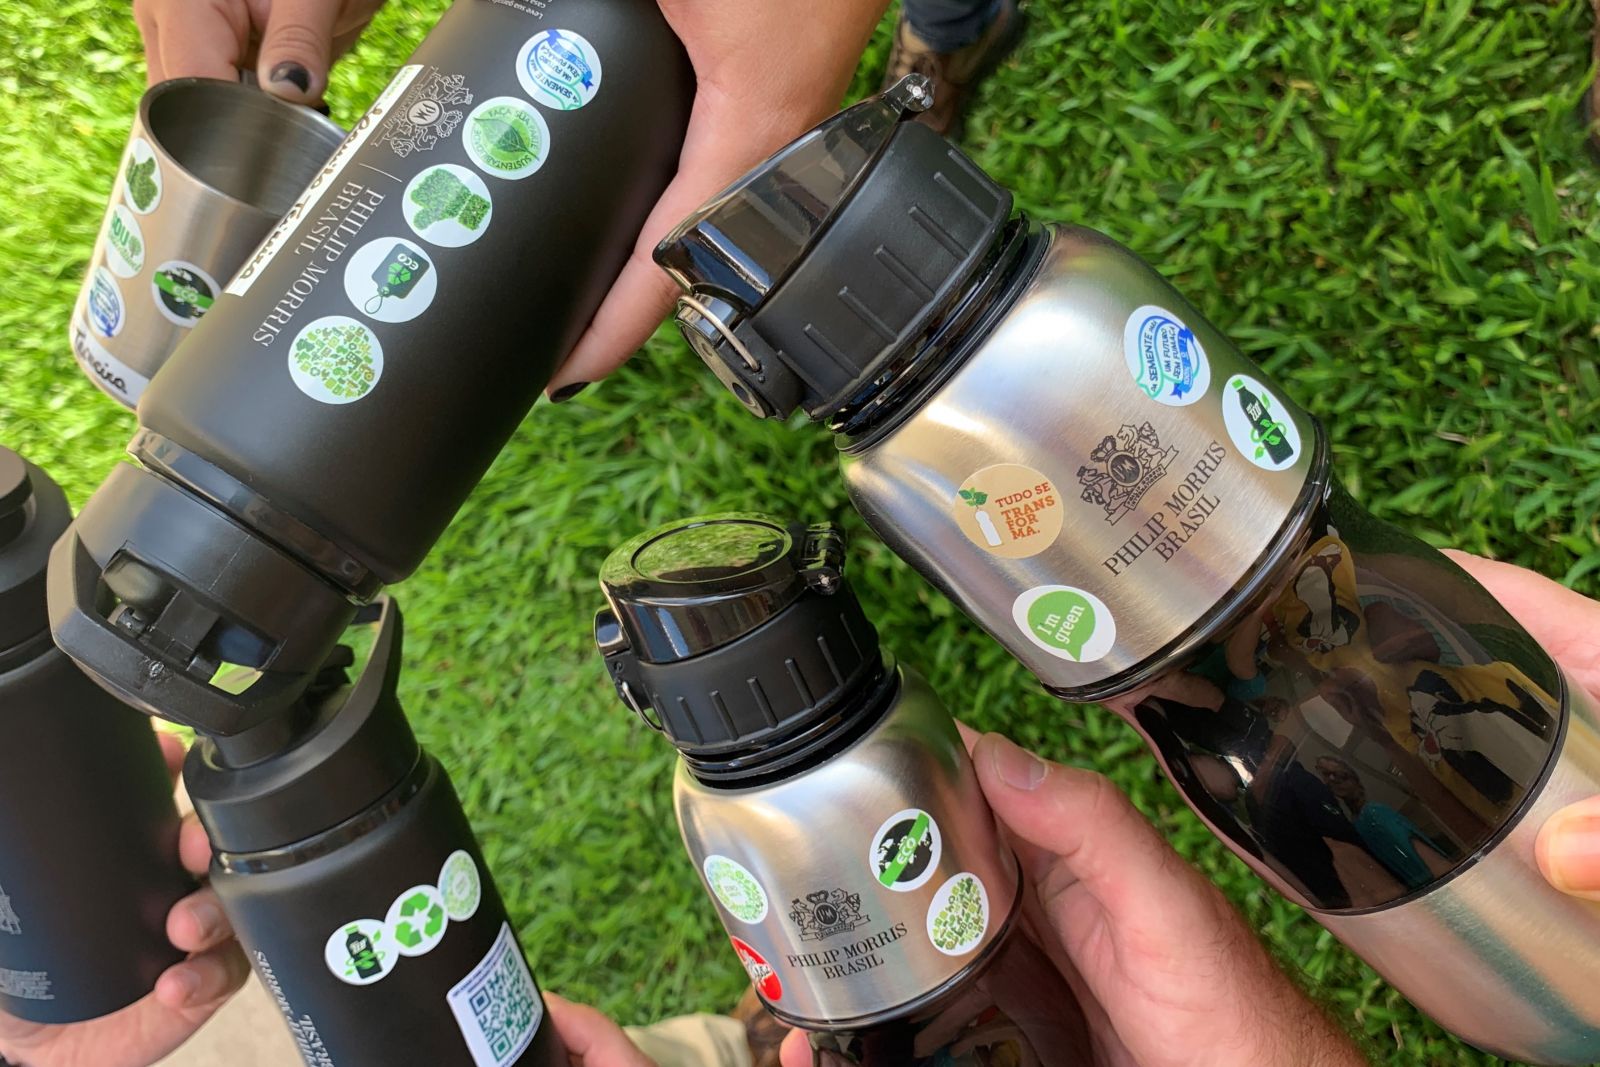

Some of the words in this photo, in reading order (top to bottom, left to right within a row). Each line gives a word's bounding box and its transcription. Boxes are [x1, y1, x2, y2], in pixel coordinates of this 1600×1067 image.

[526, 8, 543, 19] Leve
[540, 55, 563, 75] FUTURO
[562, 72, 572, 82] UM
[567, 66, 580, 78] SEM
[535, 72, 573, 99] SEMENTE
[488, 107, 512, 118] FAÇA
[515, 110, 530, 125] SUA
[294, 181, 366, 255] BRASIL
[322, 187, 386, 263] PHILIP
[252, 261, 329, 347] MORRIS
[1161, 328, 1171, 359] FUTURO
[1168, 326, 1180, 360] FUMAÇA
[1143, 333, 1159, 381] SEMENTE
[1164, 360, 1172, 373] UM
[1173, 361, 1181, 379] SEM
[995, 489, 1033, 508] TUDO
[1035, 482, 1051, 495] SE
[1001, 495, 1056, 521] TRANS
[1102, 511, 1168, 577] PHILIP
[1163, 440, 1227, 518] MORRIS
[1006, 514, 1039, 531] FOR
[1011, 525, 1041, 540] MA.
[1152, 494, 1221, 563] BRASIL
[1055, 604, 1086, 644] green
[786, 949, 840, 968] PHILIP
[842, 922, 908, 959] MORRIS
[822, 953, 885, 979] BRASIL
[286, 1015, 318, 1067] HILIP
